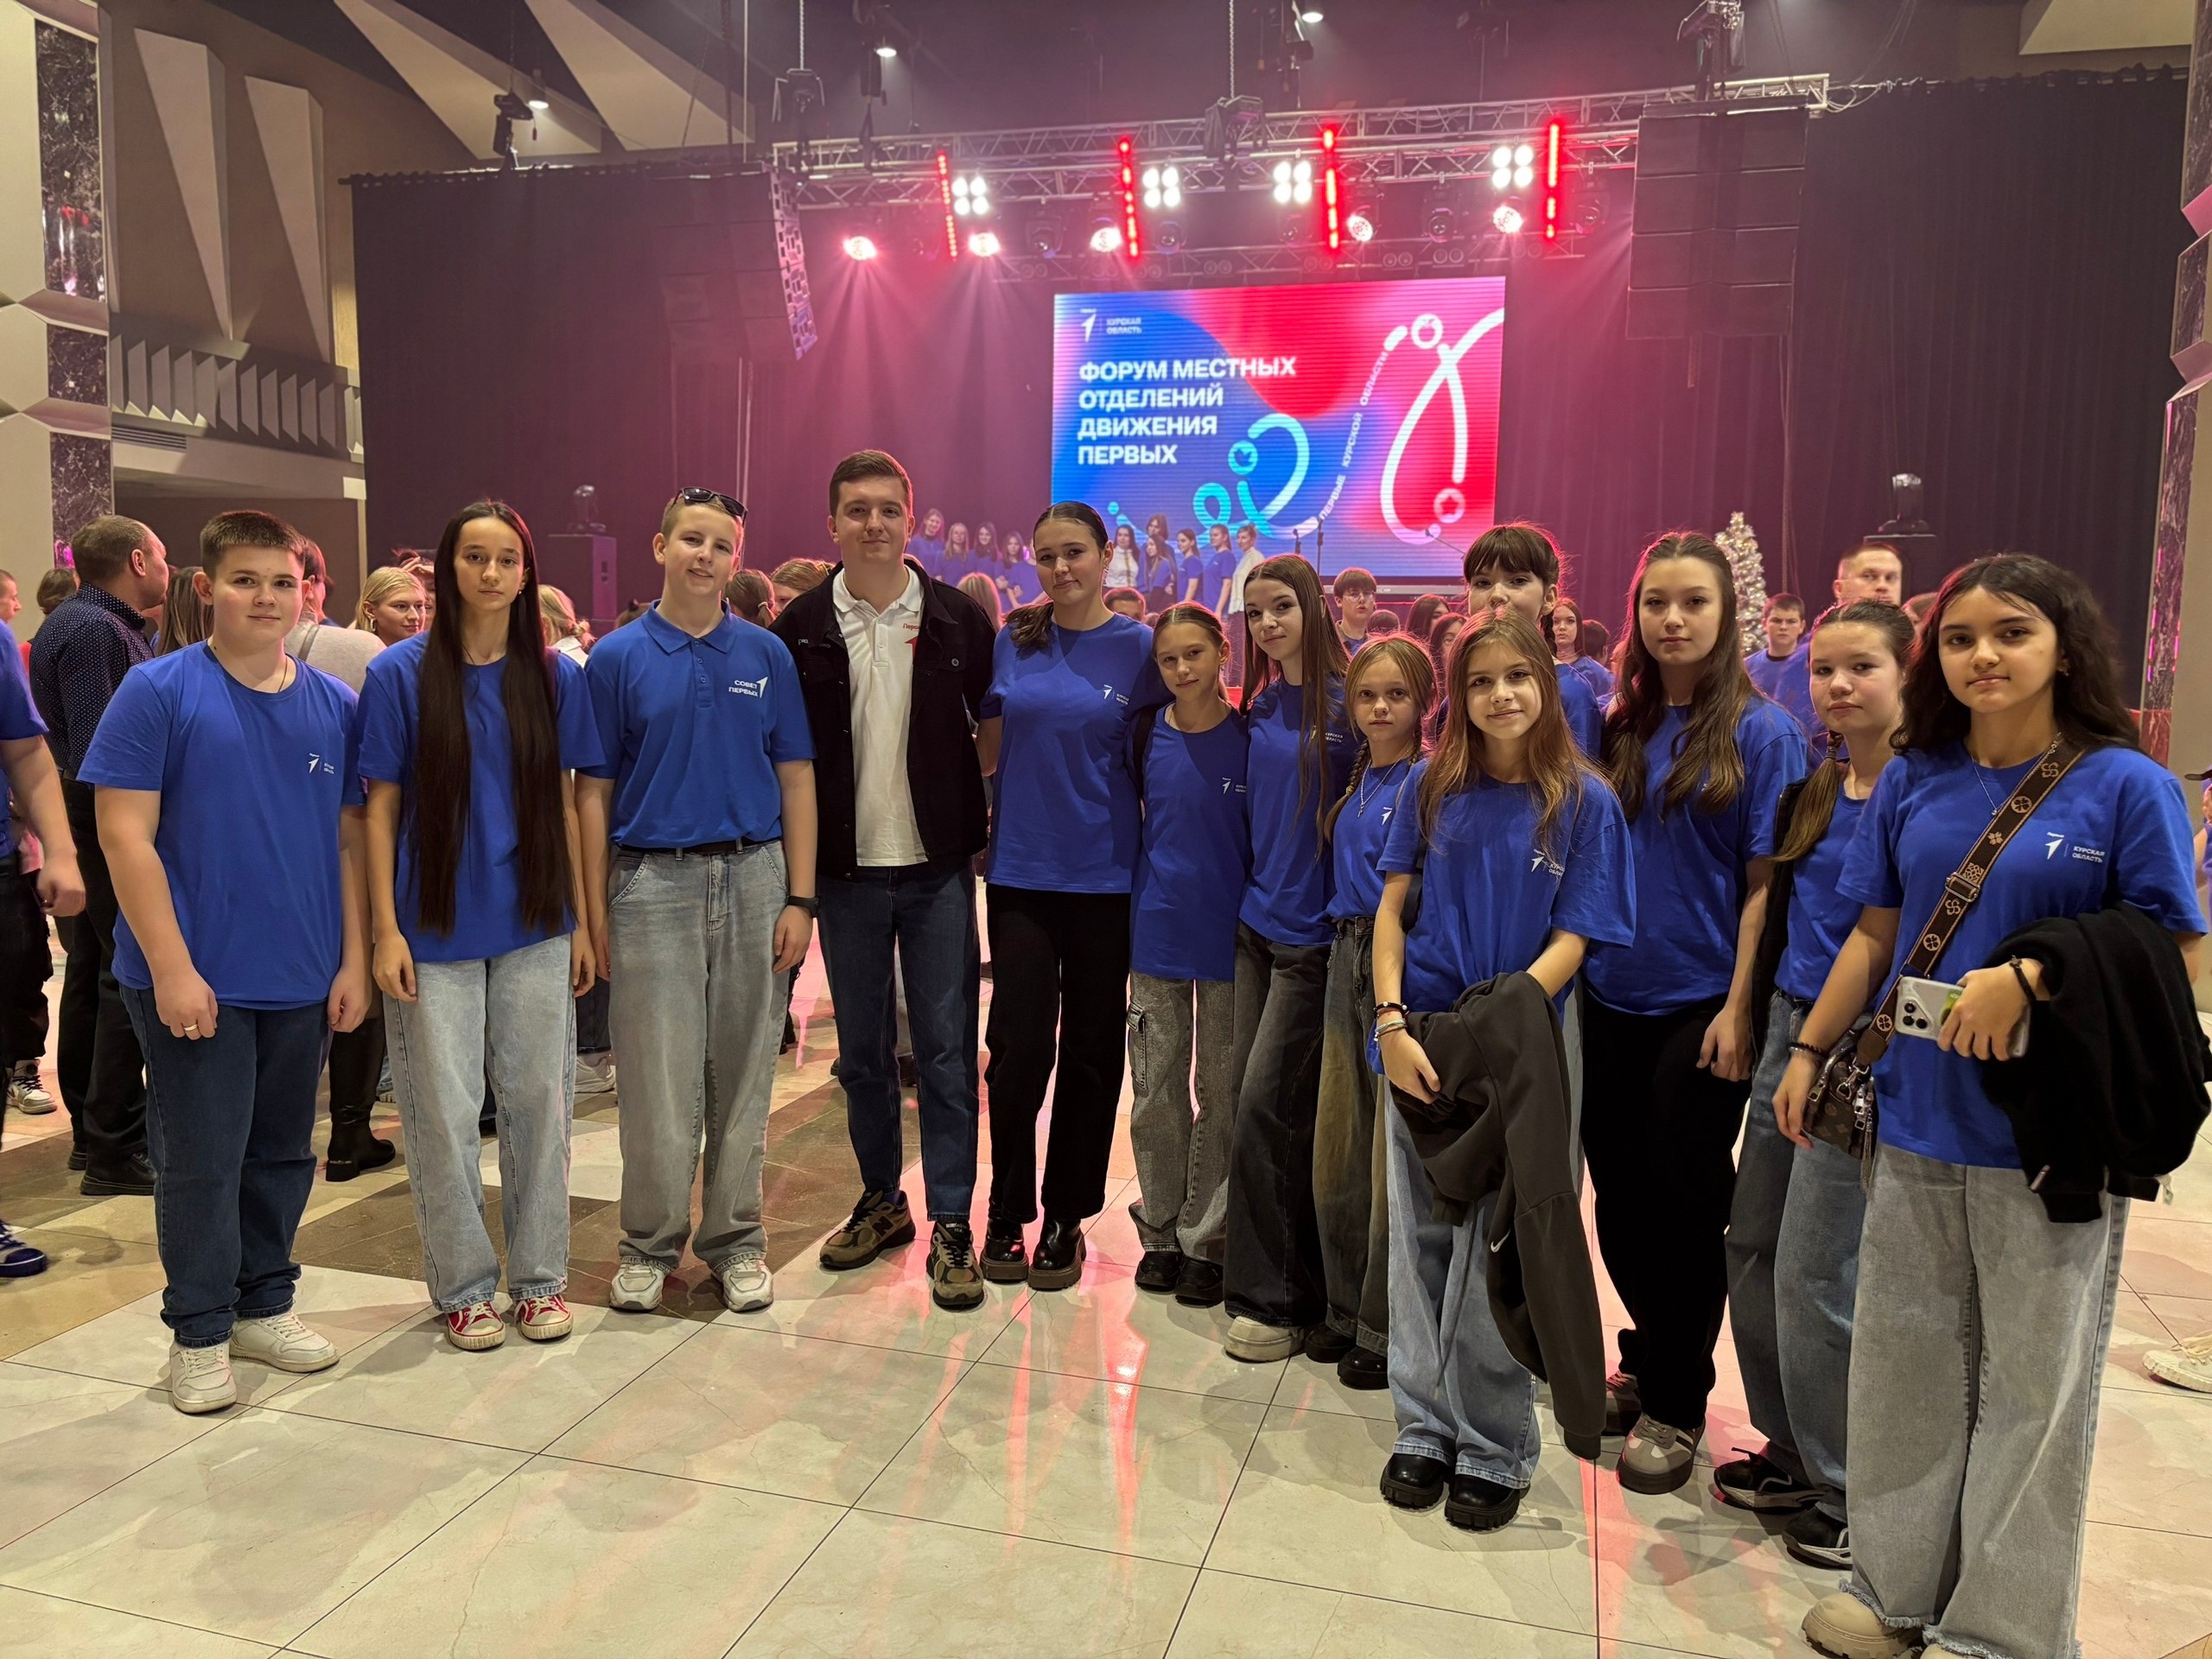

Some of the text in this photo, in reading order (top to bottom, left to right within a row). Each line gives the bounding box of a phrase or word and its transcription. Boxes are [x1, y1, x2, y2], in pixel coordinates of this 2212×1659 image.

[1079, 357, 1296, 383] ФОРУМ МЕСТНЫХ
[1078, 383, 1224, 412] ОТДЕЛЕНИЙ
[1077, 416, 1217, 441] ДВИЖЕНИЯ
[1319, 351, 1389, 520] ПЕРВЫЕ КУРСКОЙ ОБЛАСТИ
[1077, 444, 1178, 465] ПЕРВЫХ
[728, 686, 759, 697] ПЕРВЫХ
[734, 679, 758, 690] СОВЕТ
[2072, 852, 2103, 863] ОБЛАСТЬ
[2073, 846, 2106, 857] КУРСКАЯ
